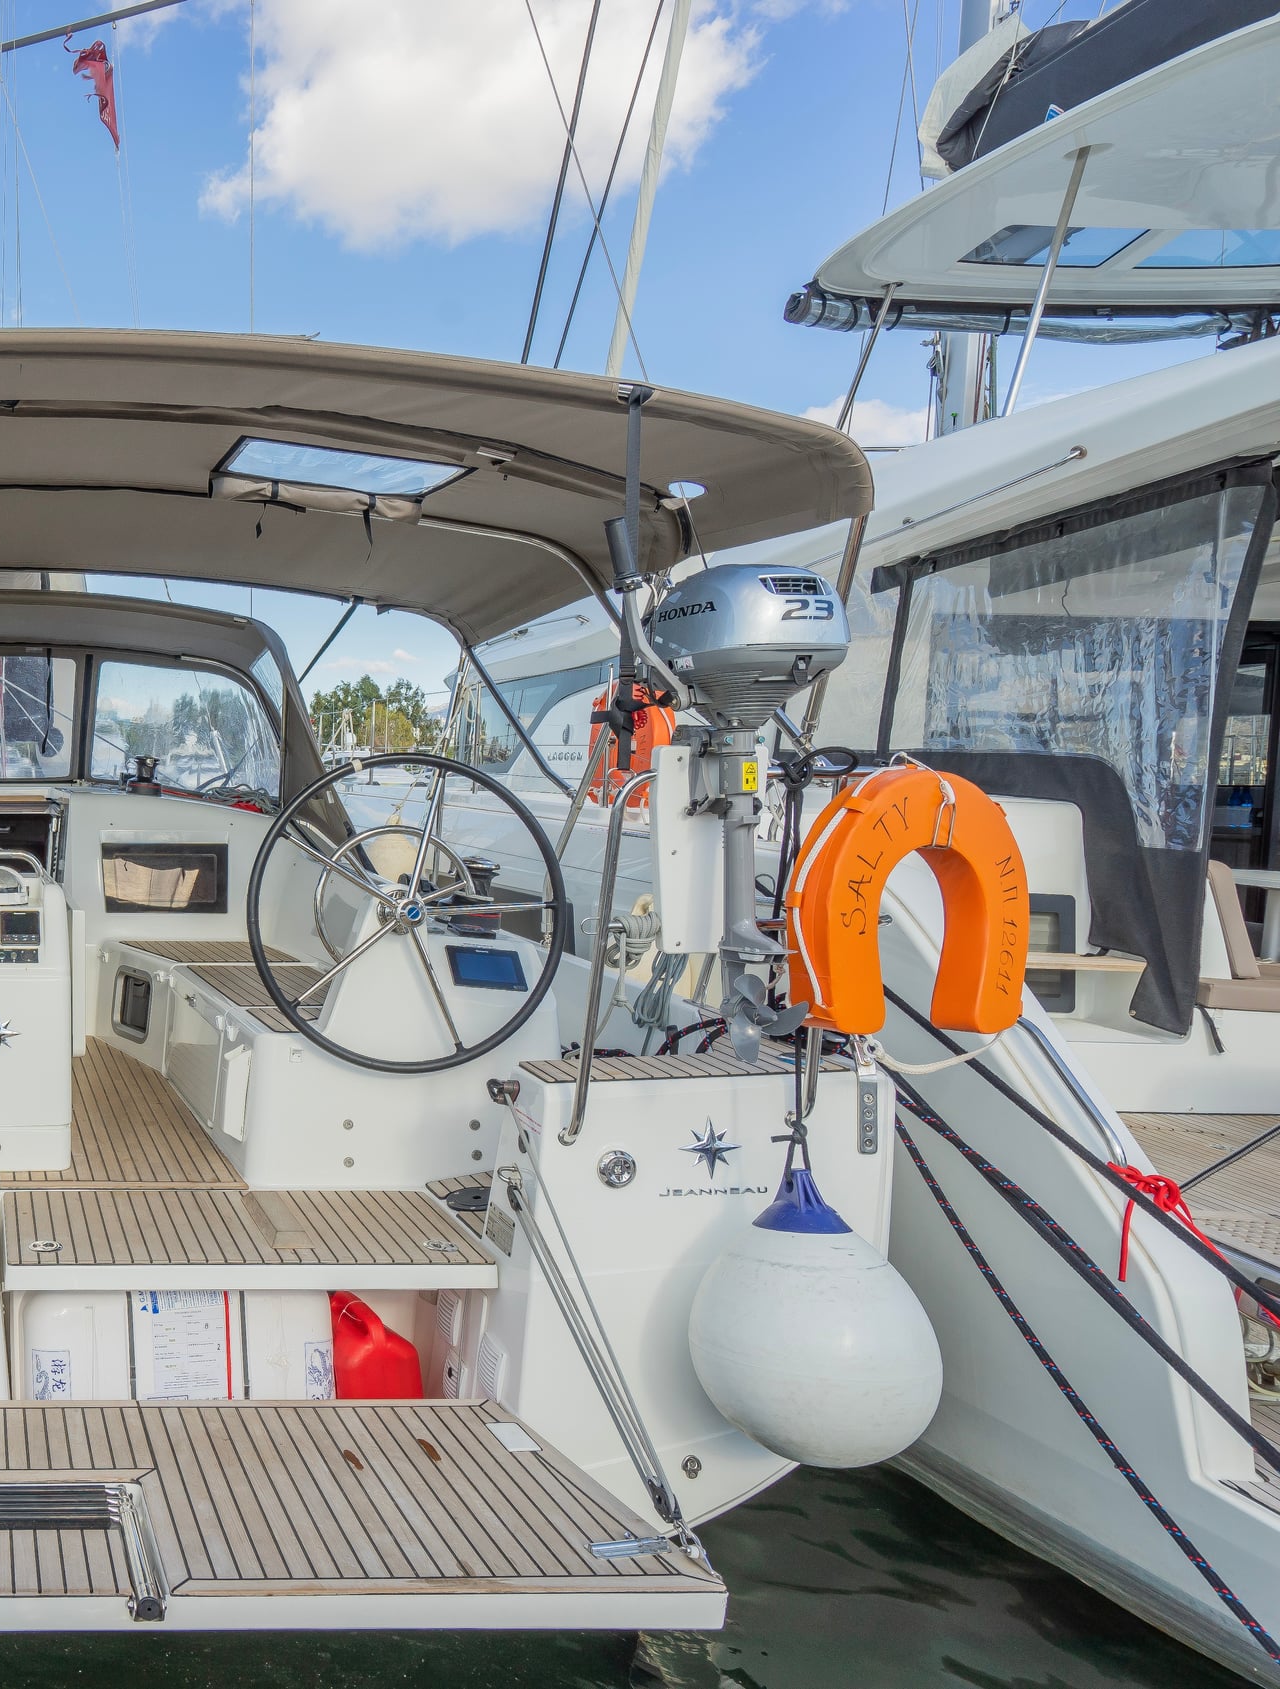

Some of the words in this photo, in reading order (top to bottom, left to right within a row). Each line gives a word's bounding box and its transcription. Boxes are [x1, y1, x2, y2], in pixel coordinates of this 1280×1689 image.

[657, 601, 717, 624] HONDA
[840, 796, 909, 936] SALTY
[658, 1186, 768, 1197] JEANNEAU
